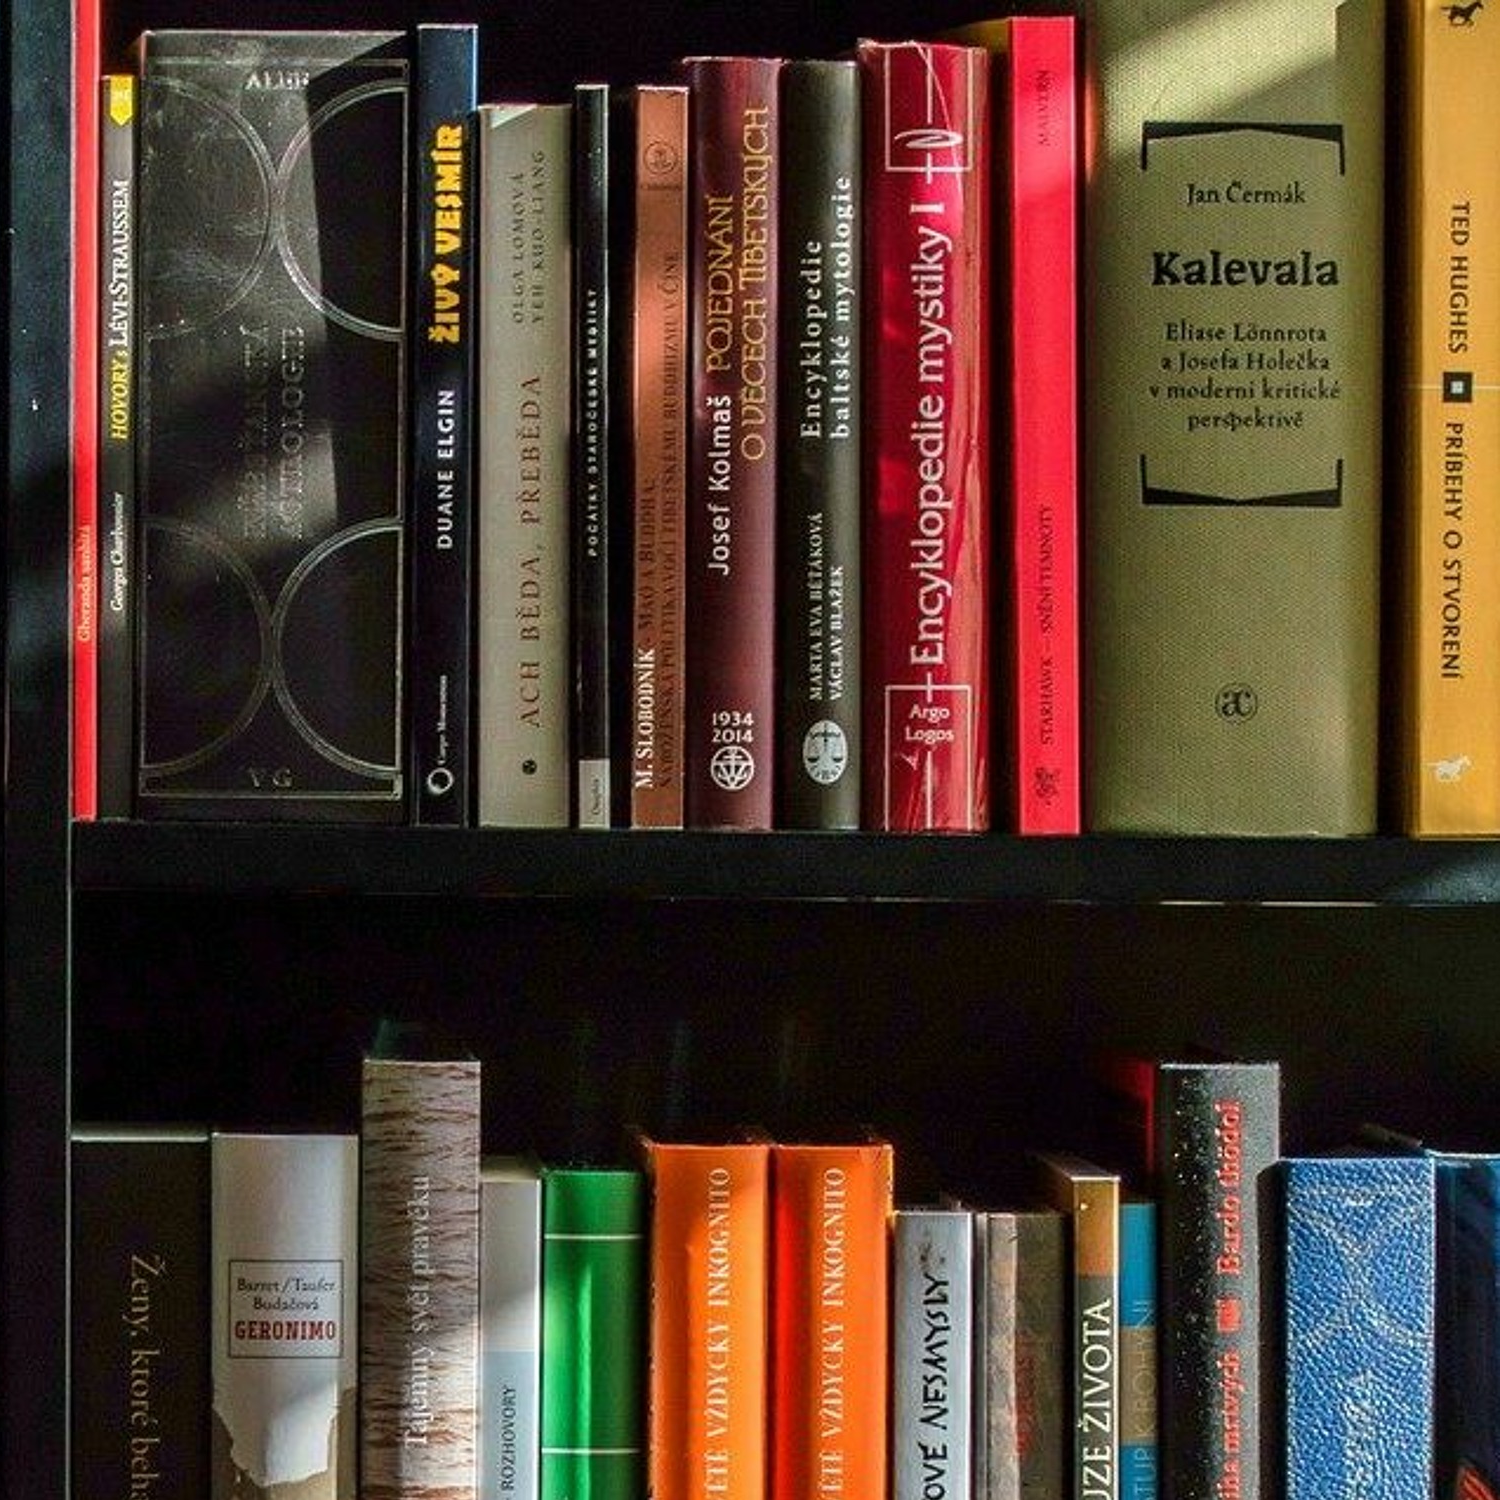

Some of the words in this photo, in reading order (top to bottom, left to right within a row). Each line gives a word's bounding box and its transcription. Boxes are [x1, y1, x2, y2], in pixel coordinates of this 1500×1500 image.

[429, 123, 463, 255] VESMÍR
[909, 202, 945, 214] I
[1186, 182, 1220, 205] Jan
[1226, 180, 1306, 205] Čermák
[1450, 201, 1470, 246] TED
[830, 175, 856, 321] mytologie
[1150, 249, 1340, 287] Kalevala
[427, 264, 461, 344] ŽIVÝ
[801, 239, 827, 439] Encyklopedie
[910, 224, 953, 384] mystiky
[1165, 321, 1225, 342] Eliase
[1233, 321, 1327, 342] Lönnrota
[1447, 257, 1469, 355] HUGHES
[830, 334, 851, 440] baltské
[1148, 386, 1160, 399] v
[1166, 378, 1255, 399] moderní
[1261, 377, 1341, 400] kritické
[1160, 358, 1173, 371] a
[1178, 351, 1239, 373] Josefa
[1246, 351, 1330, 371] Holečka
[437, 389, 455, 458] ELGIN
[708, 395, 731, 492] Kolmaš
[1186, 408, 1304, 432] perspektivě
[437, 469, 454, 550] DUANE
[1445, 421, 1464, 521] PRÍBEHY
[708, 503, 730, 576] Josef
[910, 392, 953, 666] Encyklopedie
[1442, 530, 1463, 550] O
[1441, 560, 1464, 680] STVORENÍ
[520, 659, 541, 728] ACH
[634, 647, 656, 759] SLOBODNÍK
[711, 711, 754, 727] 1934
[909, 703, 951, 721] Argo
[634, 763, 654, 788] M.
[711, 729, 754, 744] 2014
[905, 726, 955, 745] Logos
[406, 1174, 434, 1277] pravěku
[707, 1168, 731, 1307] INKOGNITO
[822, 1168, 847, 1307] INKOGNITO
[126, 1254, 166, 1336] Ženy,
[234, 1320, 336, 1341] GERONIMO
[407, 1280, 429, 1333] svět
[131, 1349, 161, 1427] ktoré
[920, 1272, 951, 1430] NESMYSLY
[1077, 1299, 1111, 1430] ŽIVOTA
[405, 1347, 434, 1447] Tajemný
[499, 1384, 517, 1492] ROZHOVORY
